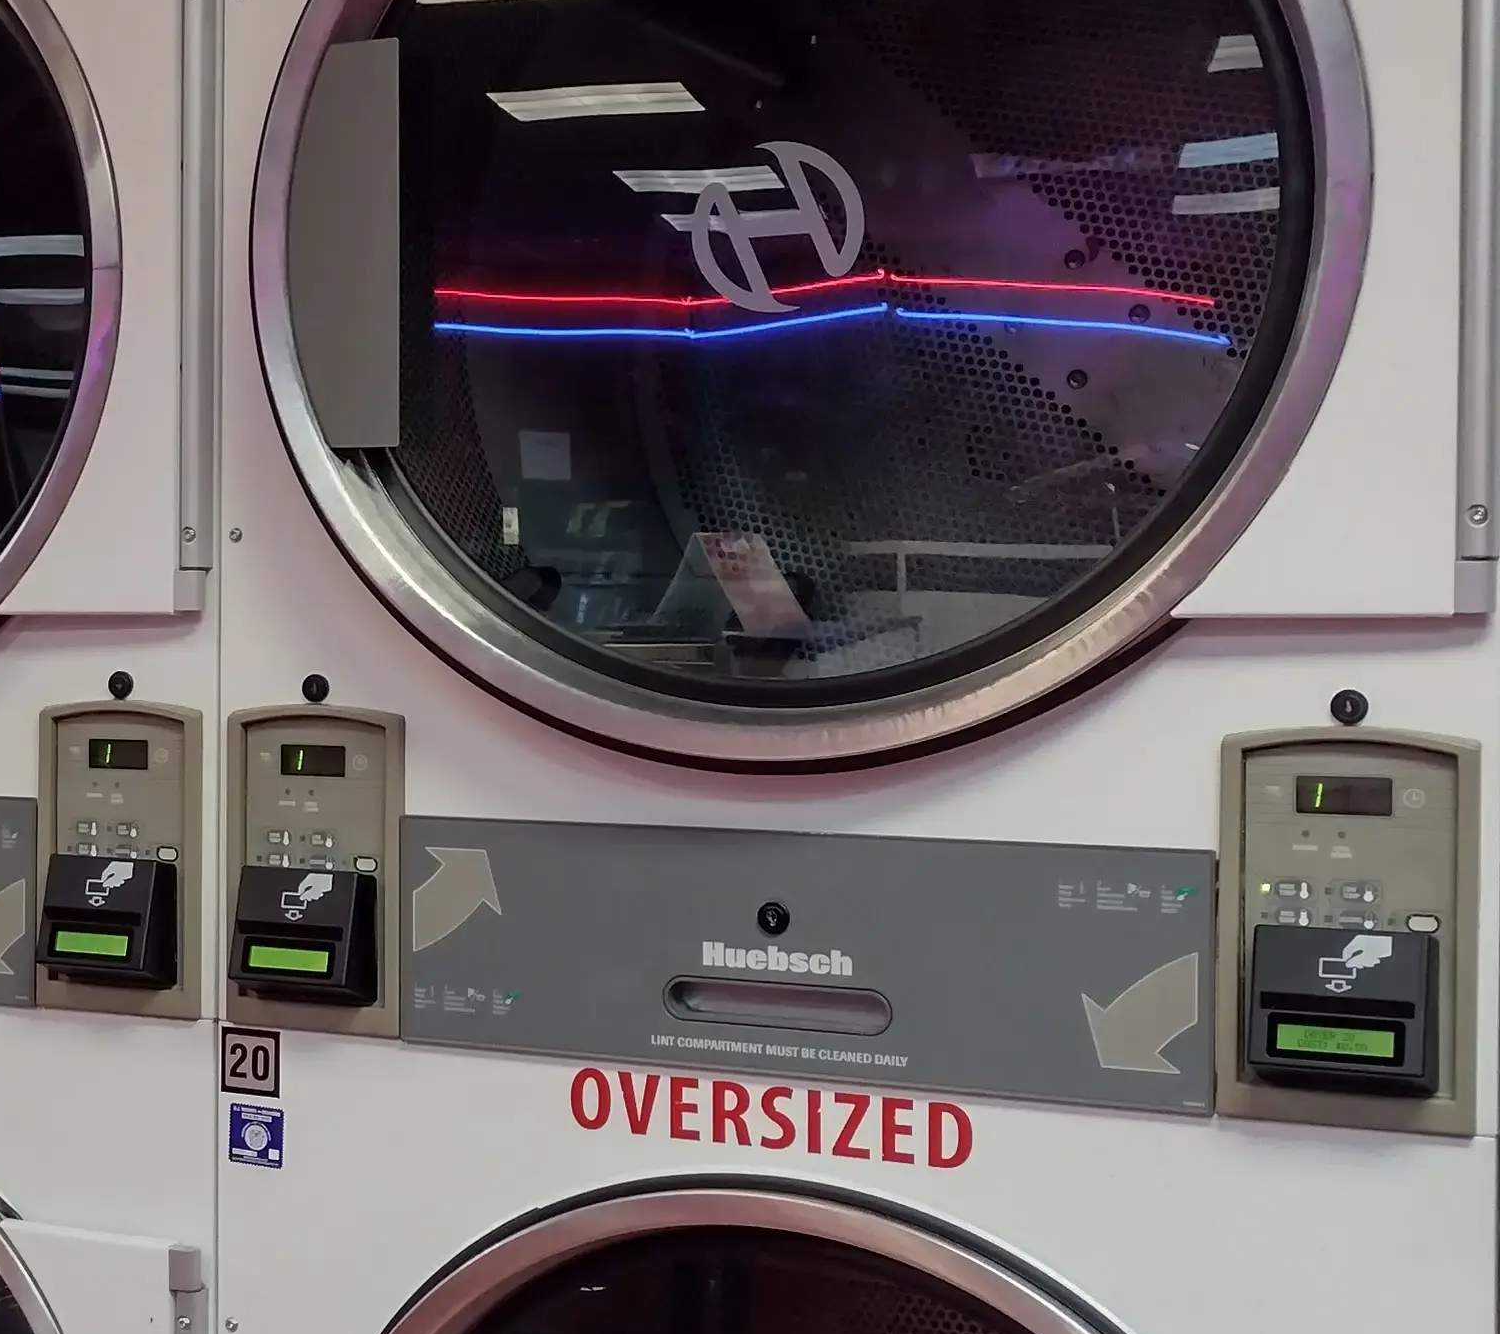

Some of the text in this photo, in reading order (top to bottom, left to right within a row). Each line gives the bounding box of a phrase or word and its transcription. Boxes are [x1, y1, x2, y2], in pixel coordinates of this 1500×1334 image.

[703, 941, 853, 976] Huebsch
[230, 1043, 270, 1082] 20
[651, 1034, 908, 1067] LINT COMPARTMENT MUST BE CLEANED DAILY
[570, 1067, 973, 1169] OVERSIZED
